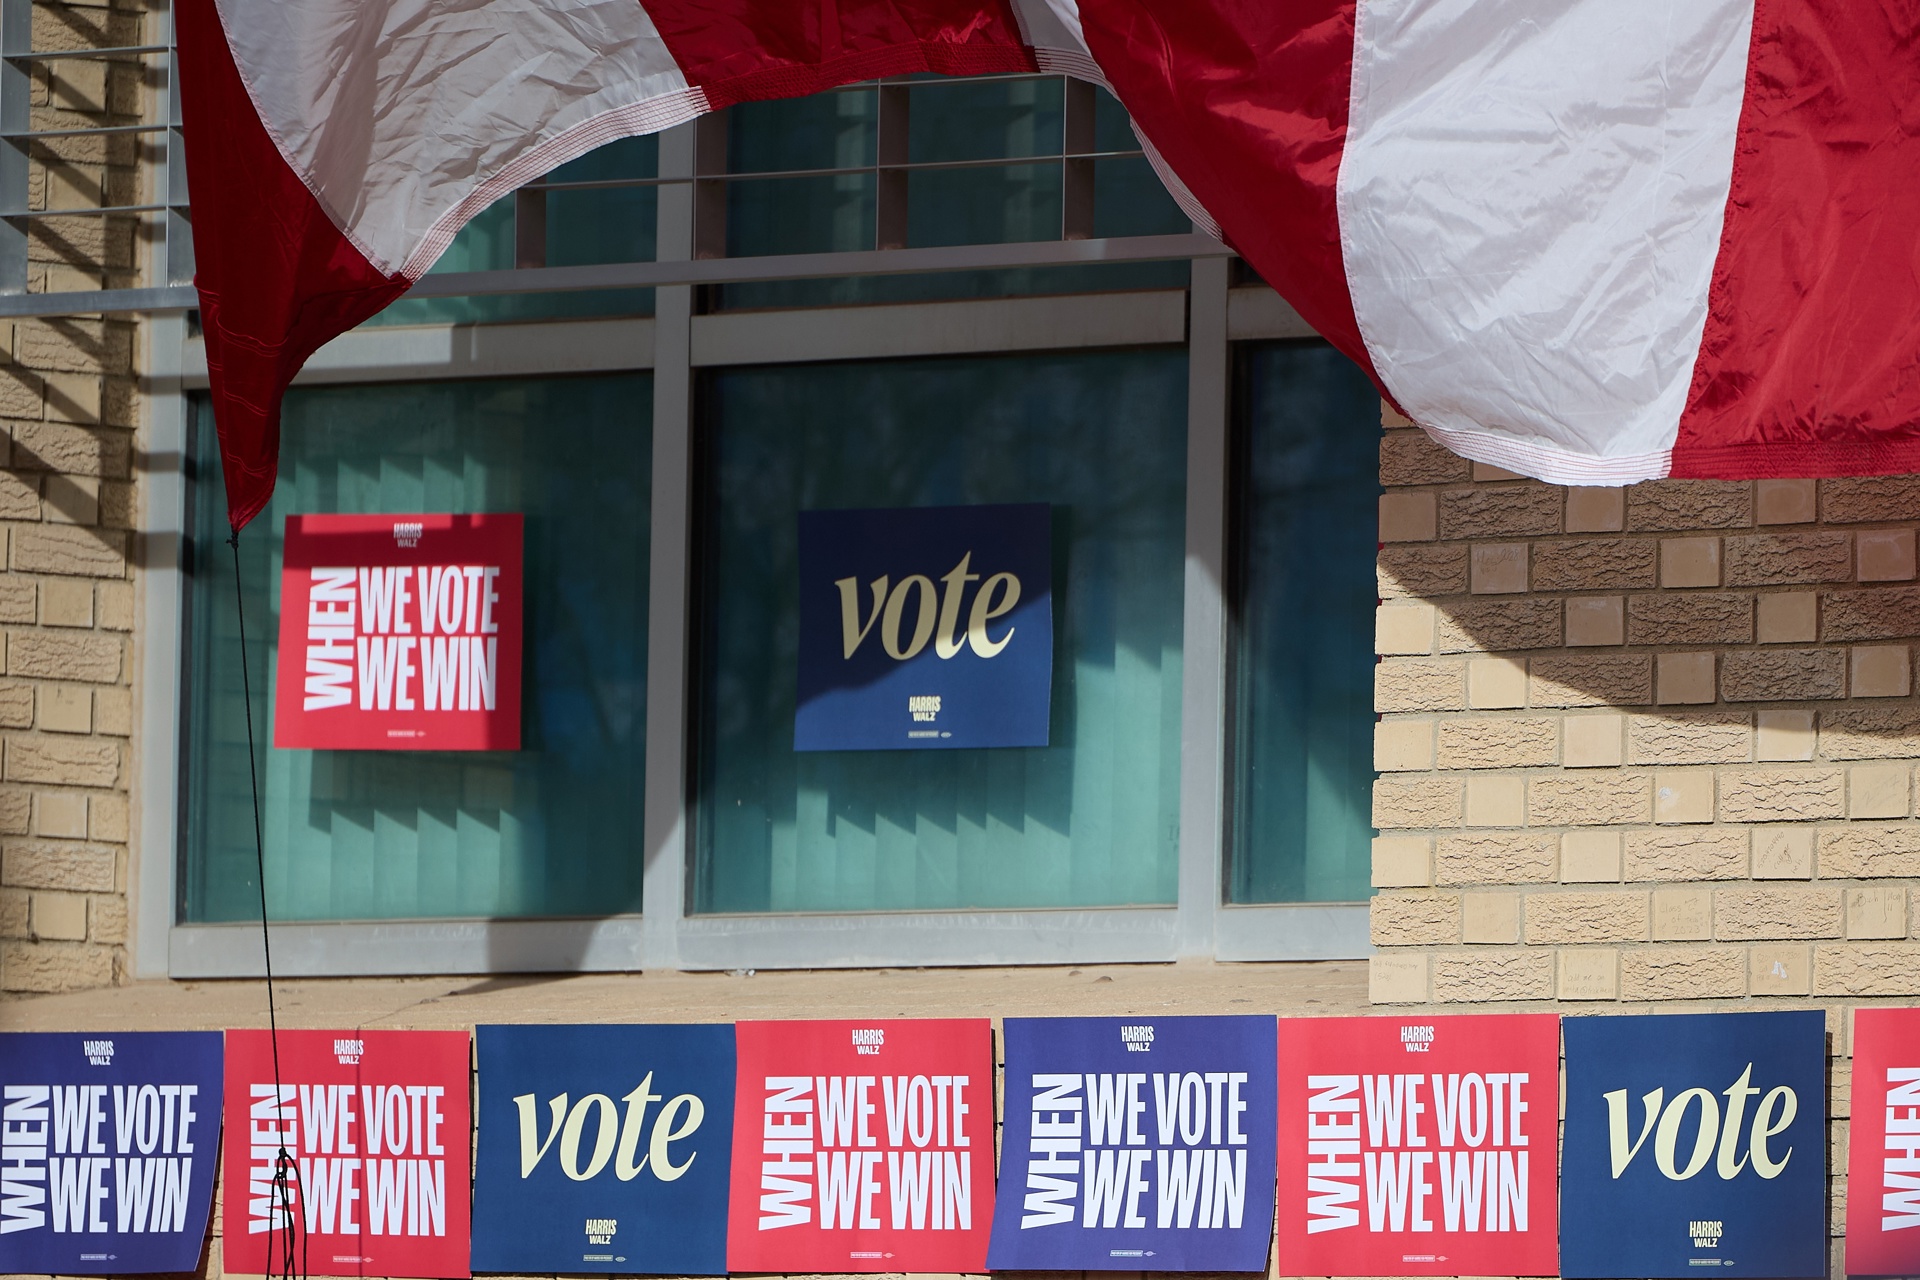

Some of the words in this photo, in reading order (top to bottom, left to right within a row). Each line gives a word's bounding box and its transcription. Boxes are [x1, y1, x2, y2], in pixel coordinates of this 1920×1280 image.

[394, 523, 423, 539] HARRIS
[398, 538, 417, 547] WALZ
[359, 567, 412, 633] WE
[418, 566, 500, 634] VOTE
[834, 550, 1021, 660] vote
[304, 566, 356, 711] WHEN
[357, 637, 416, 710] WE
[420, 636, 496, 710] WIN
[909, 696, 941, 712] HARRIS
[913, 712, 935, 721] WALZ
[84, 1041, 114, 1057] HARRIS
[89, 1055, 110, 1065] WALZ
[334, 1040, 363, 1055] HARRIS
[339, 1055, 359, 1064] WALZ
[852, 1029, 884, 1044] HARRIS
[857, 1046, 879, 1054] WALZ
[1121, 1026, 1154, 1042] HARRIS
[1127, 1043, 1150, 1051] WALZ
[1401, 1026, 1434, 1042] HARRIS
[1406, 1043, 1429, 1052] WALZ
[53, 1086, 107, 1153] WE
[113, 1085, 197, 1154] VOTE
[300, 1085, 355, 1154] WE
[362, 1085, 444, 1155] VOTE
[513, 1071, 704, 1181] vote
[816, 1076, 876, 1146] WE
[882, 1075, 970, 1147] VOTE
[1086, 1074, 1146, 1145] WE
[1153, 1072, 1247, 1145] VOTE
[1363, 1074, 1426, 1147] WE
[1432, 1073, 1528, 1147] VOTE
[1603, 1063, 1797, 1180] vote
[0, 1086, 49, 1234] WHEN
[249, 1084, 297, 1234] WHEN
[759, 1077, 813, 1230] WHEN
[1021, 1074, 1082, 1229] WHEN
[1308, 1075, 1360, 1234] WHEN
[1882, 1068, 1920, 1231] WHEN
[49, 1158, 110, 1232] WE
[115, 1158, 192, 1232] WIN
[300, 1158, 361, 1234] WE
[366, 1159, 445, 1236] WIN
[817, 1152, 882, 1229] WE
[888, 1152, 971, 1229] WIN
[1083, 1150, 1151, 1228] WE
[1157, 1150, 1247, 1228] WIN
[1364, 1152, 1433, 1232] WE
[1439, 1151, 1528, 1232] WIN
[586, 1220, 616, 1235] HARRIS
[590, 1235, 611, 1244] WALZ
[1690, 1221, 1722, 1237] HARRIS
[1694, 1238, 1717, 1247] WALZ
